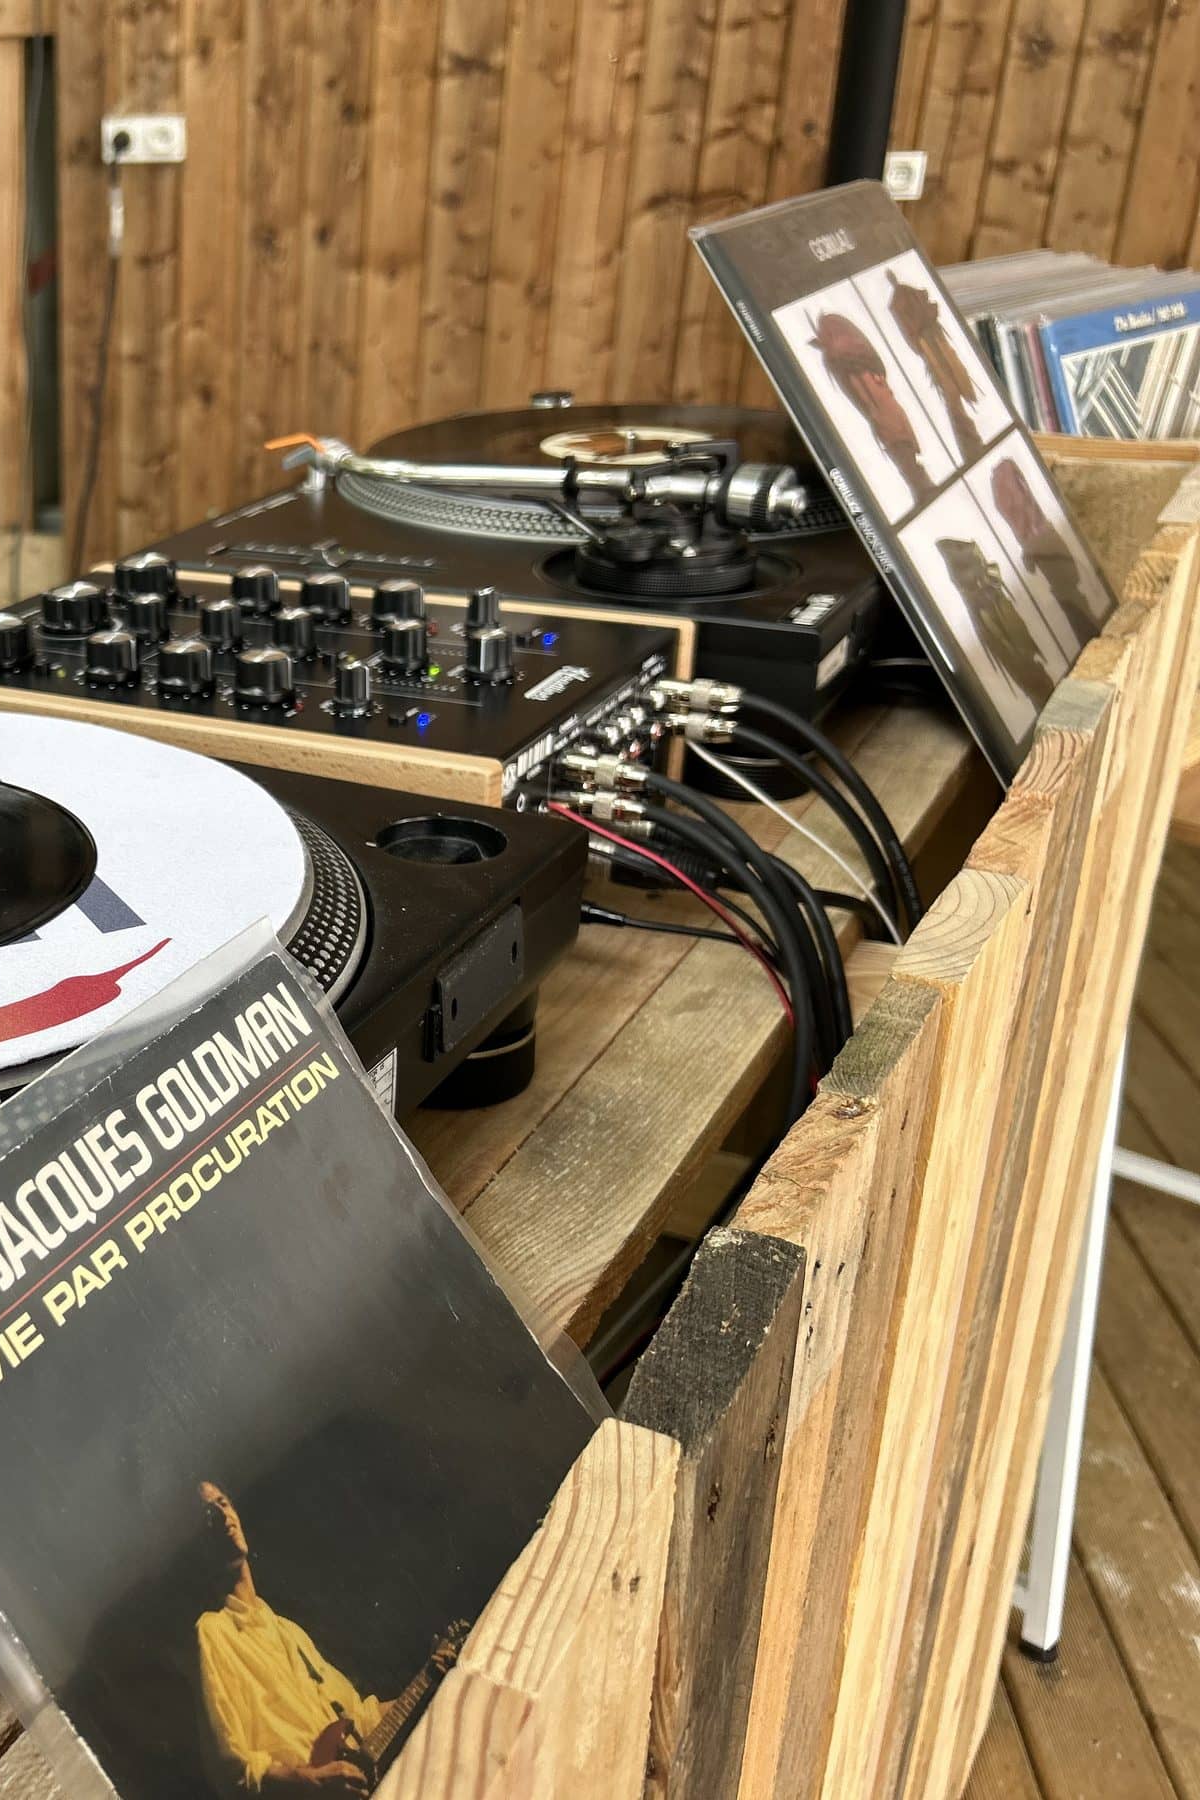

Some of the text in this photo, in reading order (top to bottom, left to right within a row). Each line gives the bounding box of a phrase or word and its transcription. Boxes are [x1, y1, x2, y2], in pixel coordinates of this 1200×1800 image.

[136, 982, 313, 1151] GOLDMAN
[42, 1239, 128, 1327] PAR
[124, 1052, 340, 1253] PROCURATION
